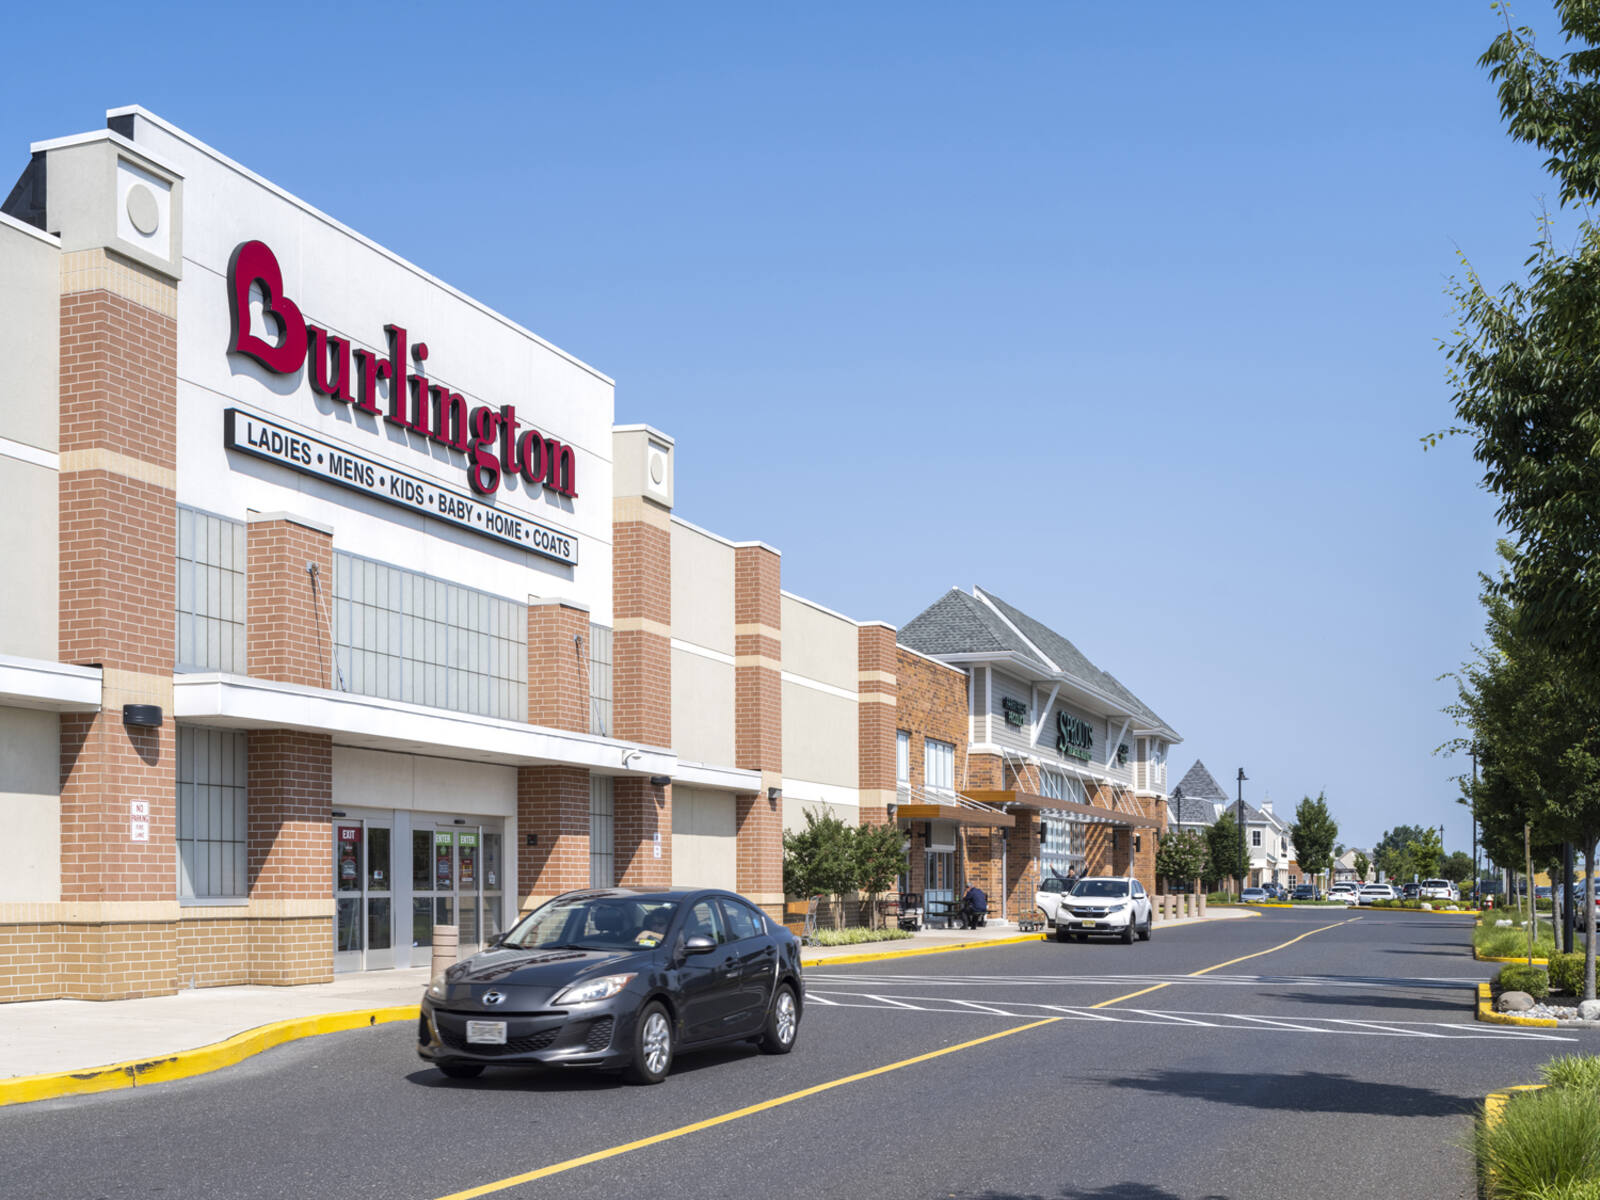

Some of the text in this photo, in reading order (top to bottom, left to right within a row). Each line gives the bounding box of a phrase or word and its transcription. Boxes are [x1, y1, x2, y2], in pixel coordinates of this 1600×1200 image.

[226, 240, 579, 498] Burlington
[247, 422, 570, 557] LADIES MENS KIDS BABY HOME COATS
[342, 829, 356, 840] EXIT
[435, 834, 451, 843] ENTER
[460, 835, 475, 845] ENTER
